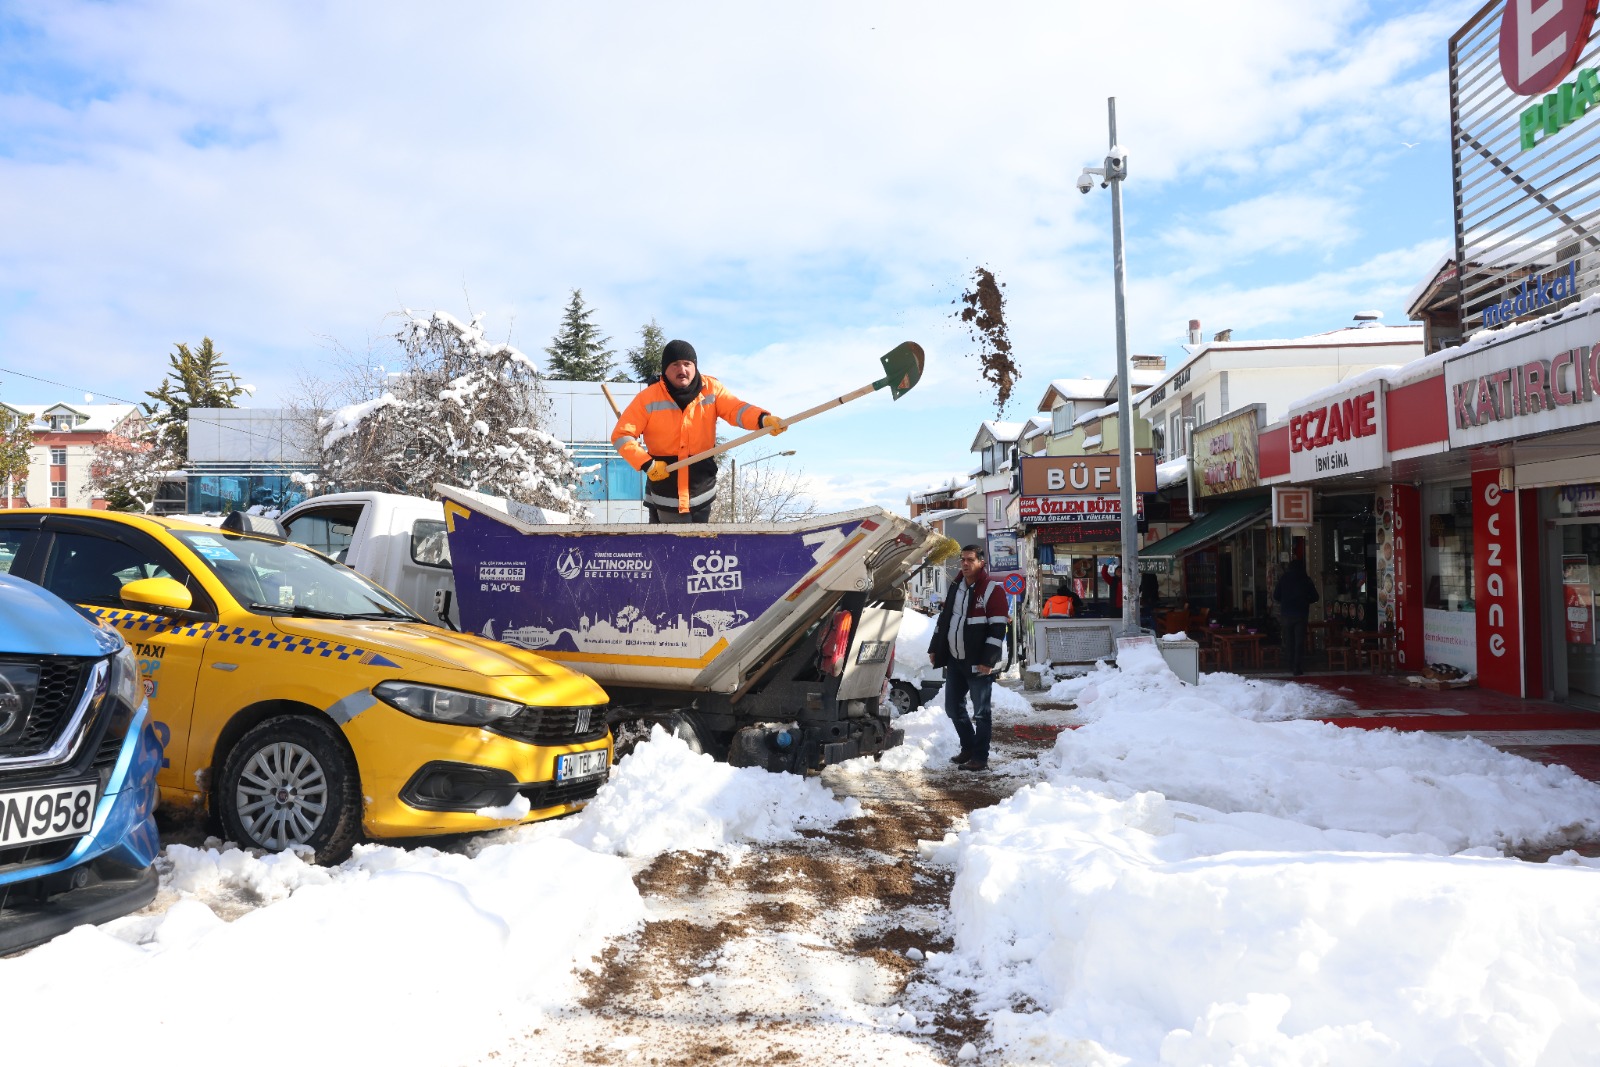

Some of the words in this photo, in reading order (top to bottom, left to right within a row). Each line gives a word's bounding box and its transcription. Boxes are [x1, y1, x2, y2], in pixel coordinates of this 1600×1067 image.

[1517, 0, 1566, 86] E
[1483, 260, 1576, 328] medikal
[1290, 390, 1376, 453] ECZANE
[1315, 452, 1330, 472] İBNİ
[1330, 450, 1349, 470] SİNA
[1047, 462, 1120, 490] BÜF
[1041, 497, 1085, 514] ÖZLEM
[1087, 496, 1121, 513] BÜFE
[1284, 495, 1304, 519] E
[1047, 514, 1072, 522] ÖDEME
[1085, 513, 1116, 521] YÜKLEME
[480, 568, 496, 576] 444
[498, 568, 505, 576] 4
[507, 568, 524, 576] 052
[584, 559, 653, 570] ALTINORDU
[692, 550, 739, 575] ÇÖP
[1484, 482, 1506, 658] eczane
[687, 574, 741, 592] TAKSİ
[135, 643, 166, 659] TAXI
[563, 757, 573, 777] 34
[579, 754, 592, 775] TEC
